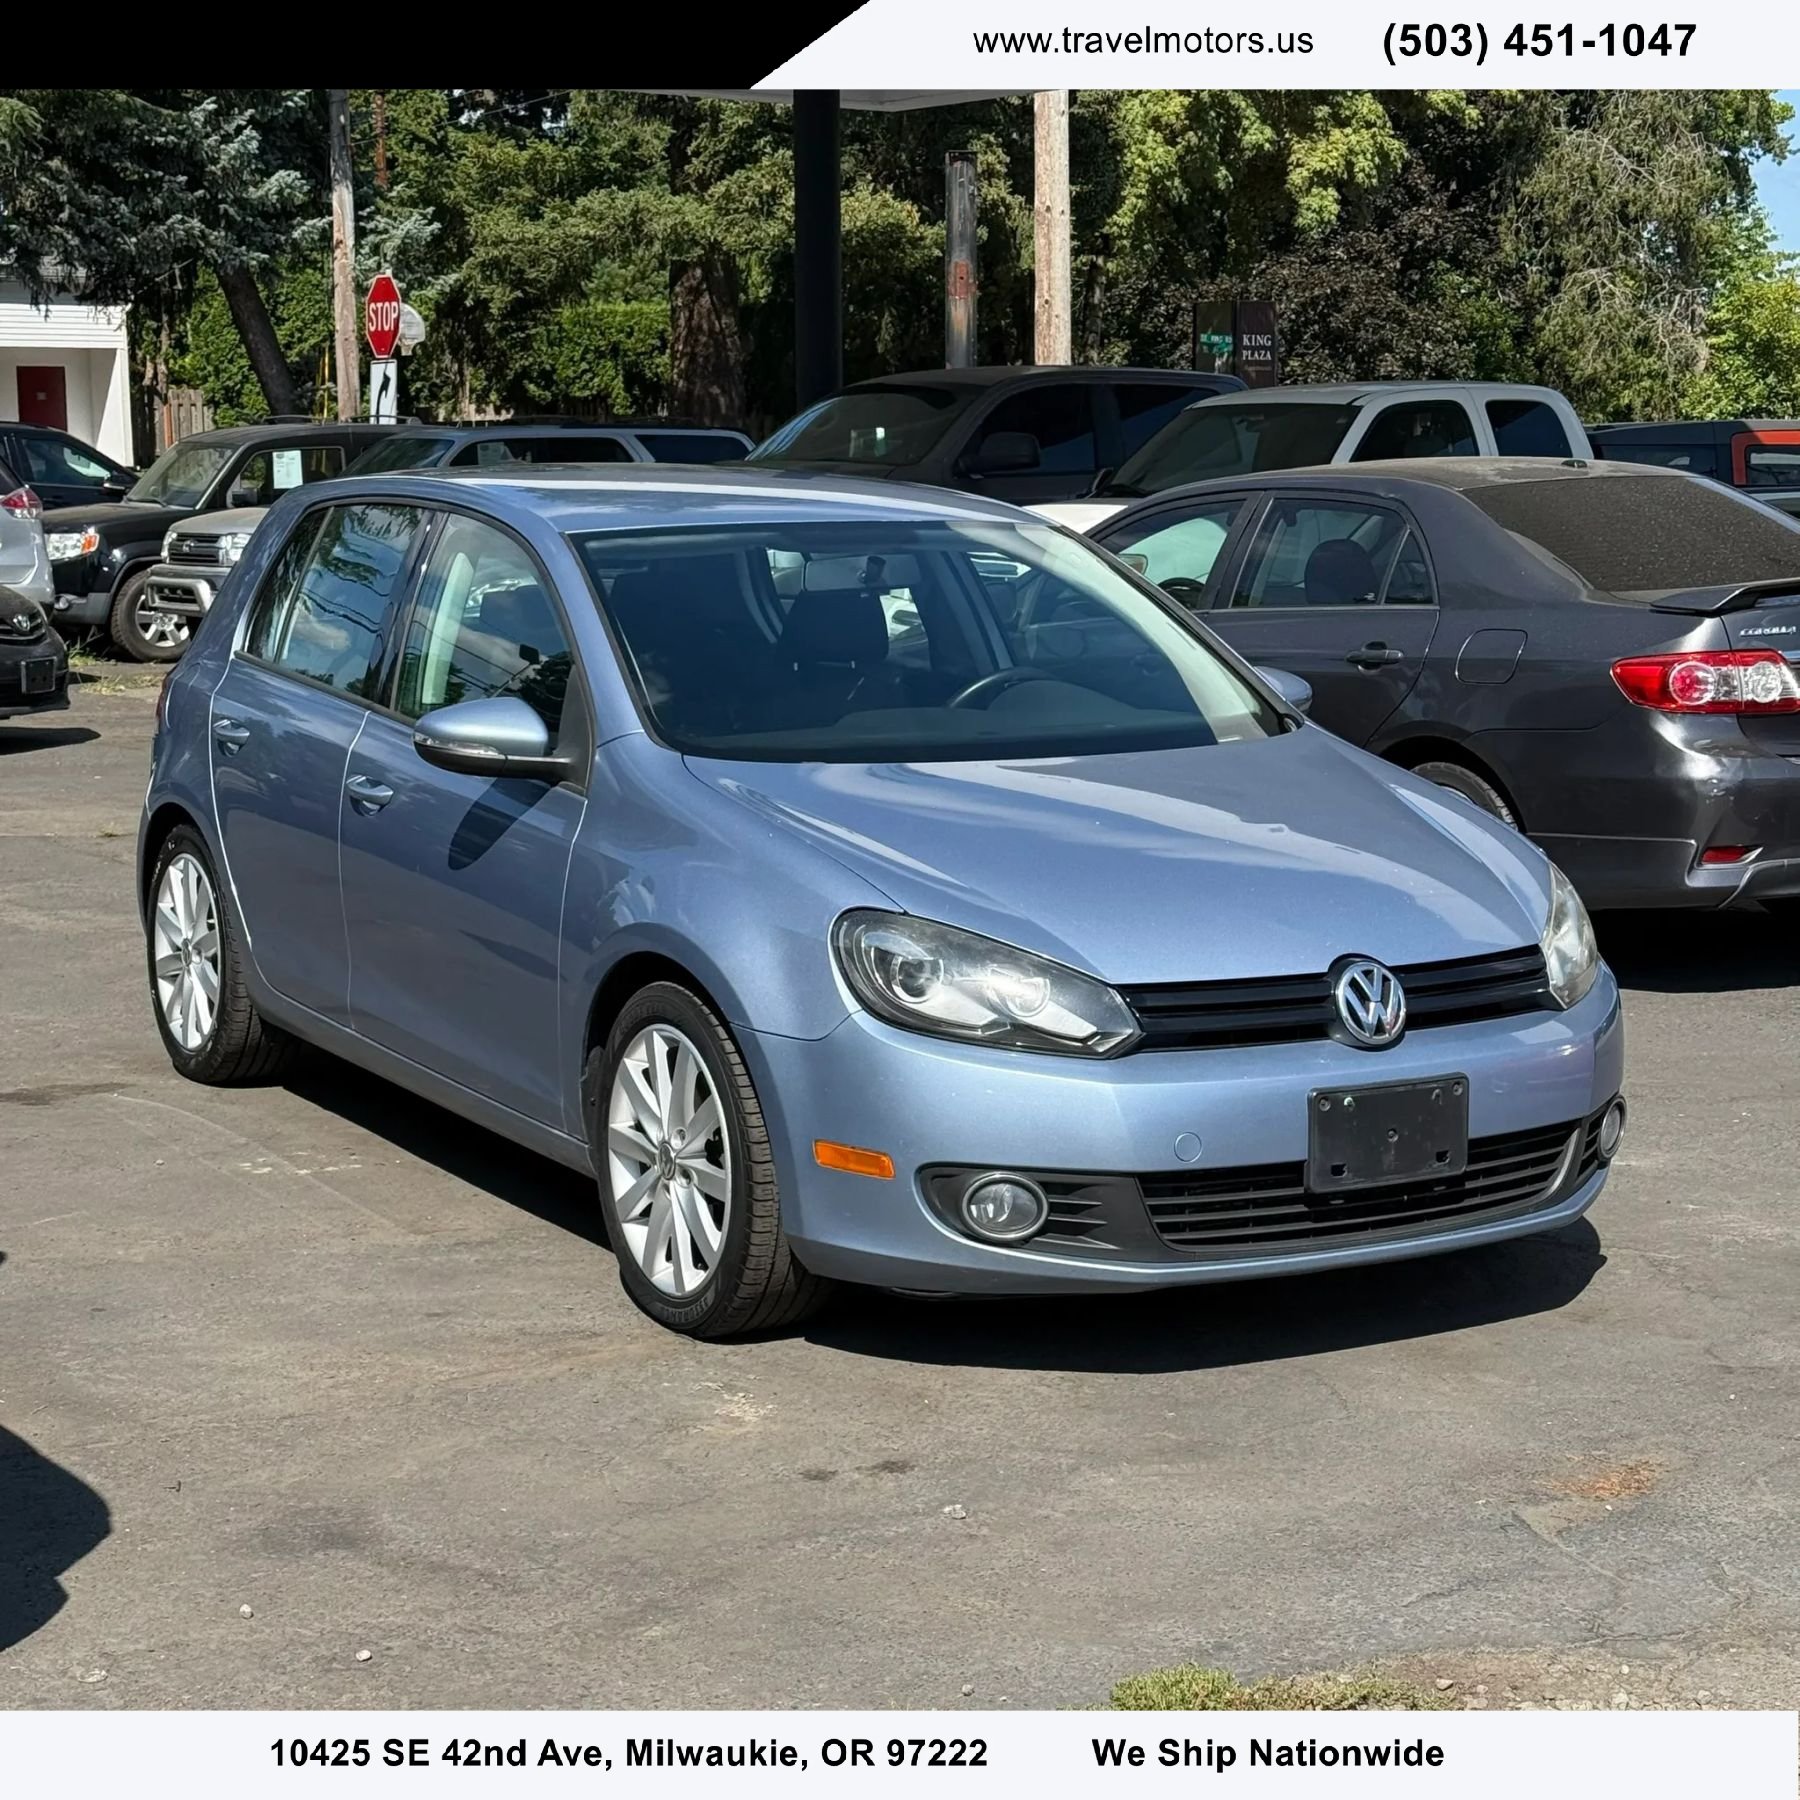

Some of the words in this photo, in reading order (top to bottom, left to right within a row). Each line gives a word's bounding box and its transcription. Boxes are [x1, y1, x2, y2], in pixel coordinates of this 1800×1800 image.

[369, 302, 399, 332] STOP
[1243, 334, 1272, 346] KING
[1242, 350, 1272, 360] PLAZA
